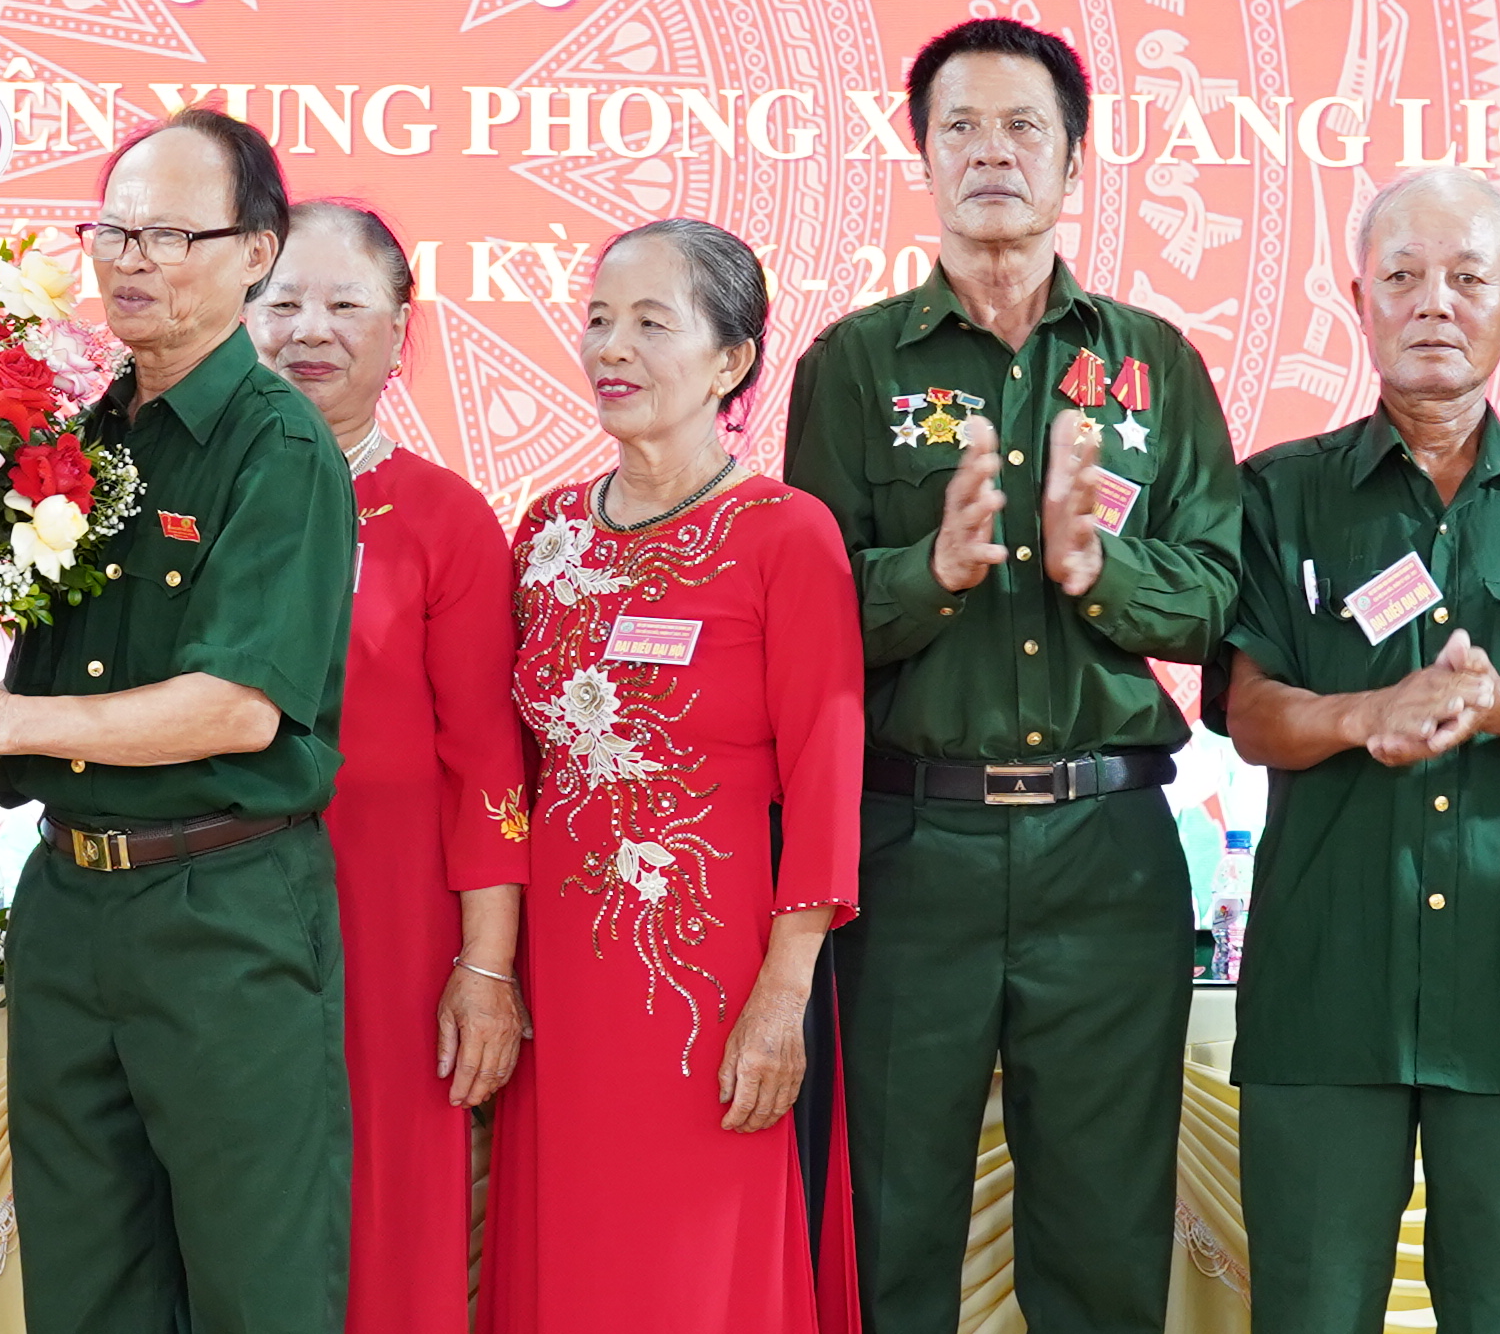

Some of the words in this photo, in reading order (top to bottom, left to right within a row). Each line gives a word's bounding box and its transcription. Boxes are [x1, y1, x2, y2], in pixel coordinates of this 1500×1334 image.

[461, 84, 821, 161] PHONG
[843, 89, 919, 161] X
[1090, 92, 1371, 168] UANG
[466, 222, 590, 304] KỲ
